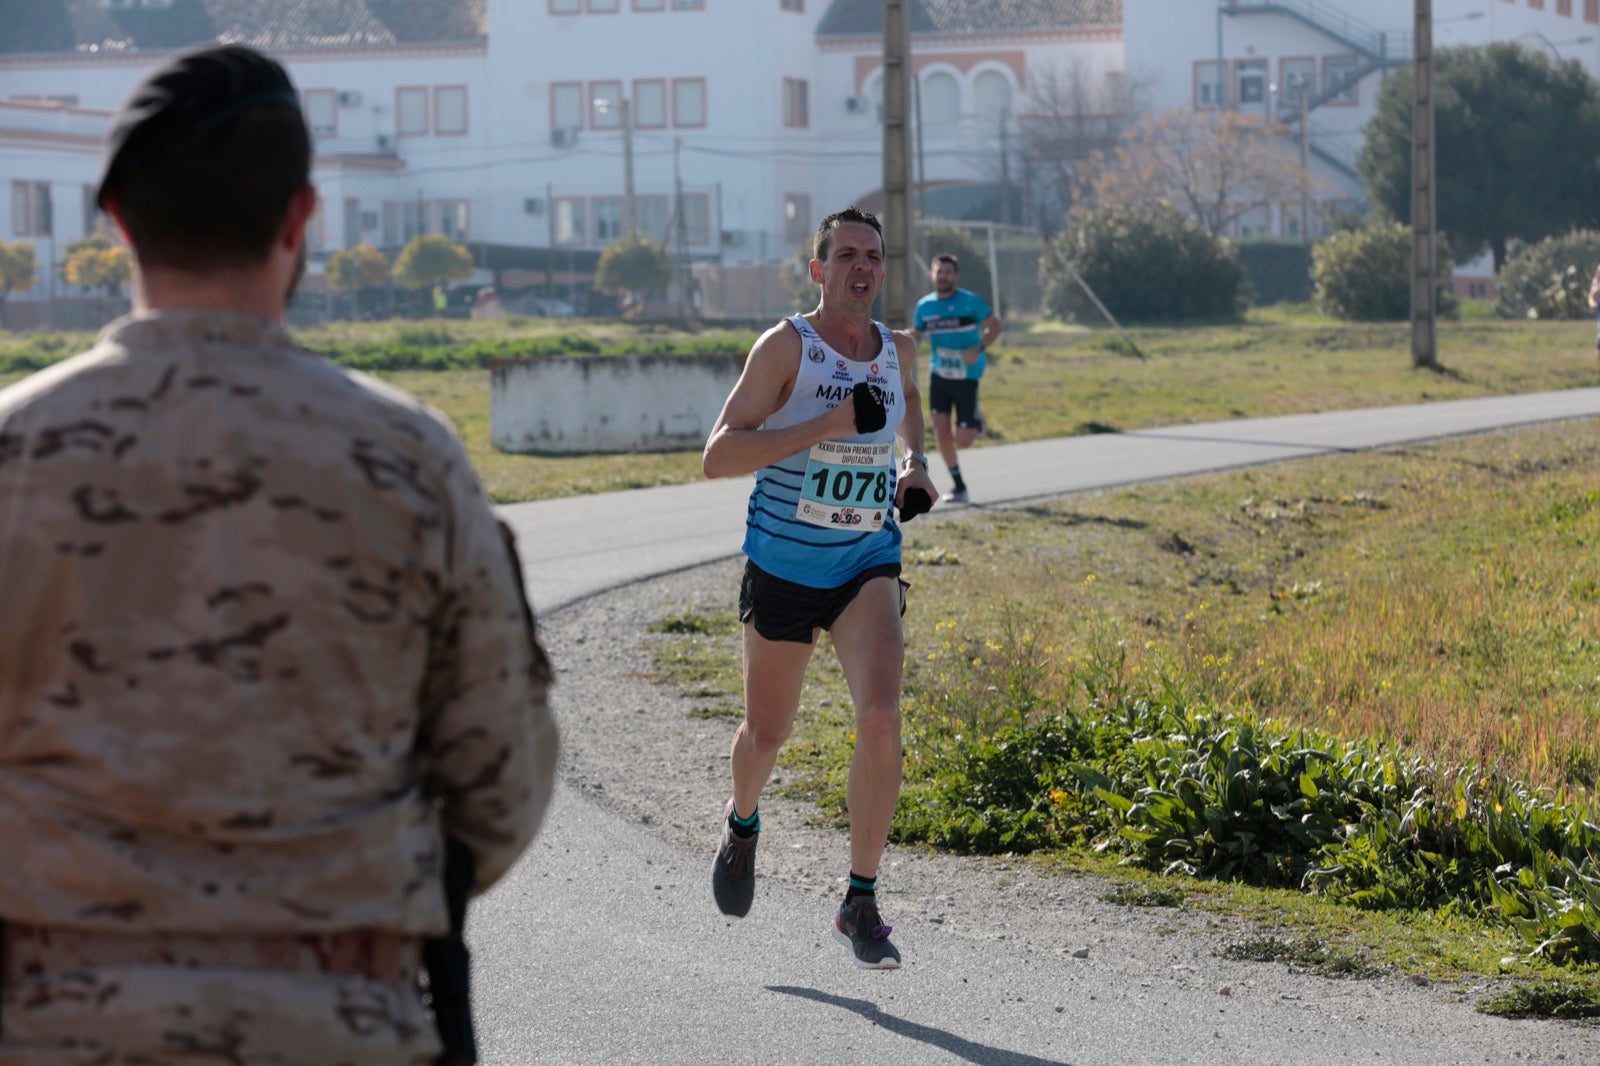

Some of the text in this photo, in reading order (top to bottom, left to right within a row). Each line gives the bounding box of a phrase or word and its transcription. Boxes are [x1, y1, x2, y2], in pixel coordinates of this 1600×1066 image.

[836, 445, 852, 454] GRAN
[852, 446, 872, 455] PREMIO
[811, 468, 887, 503] 1078
